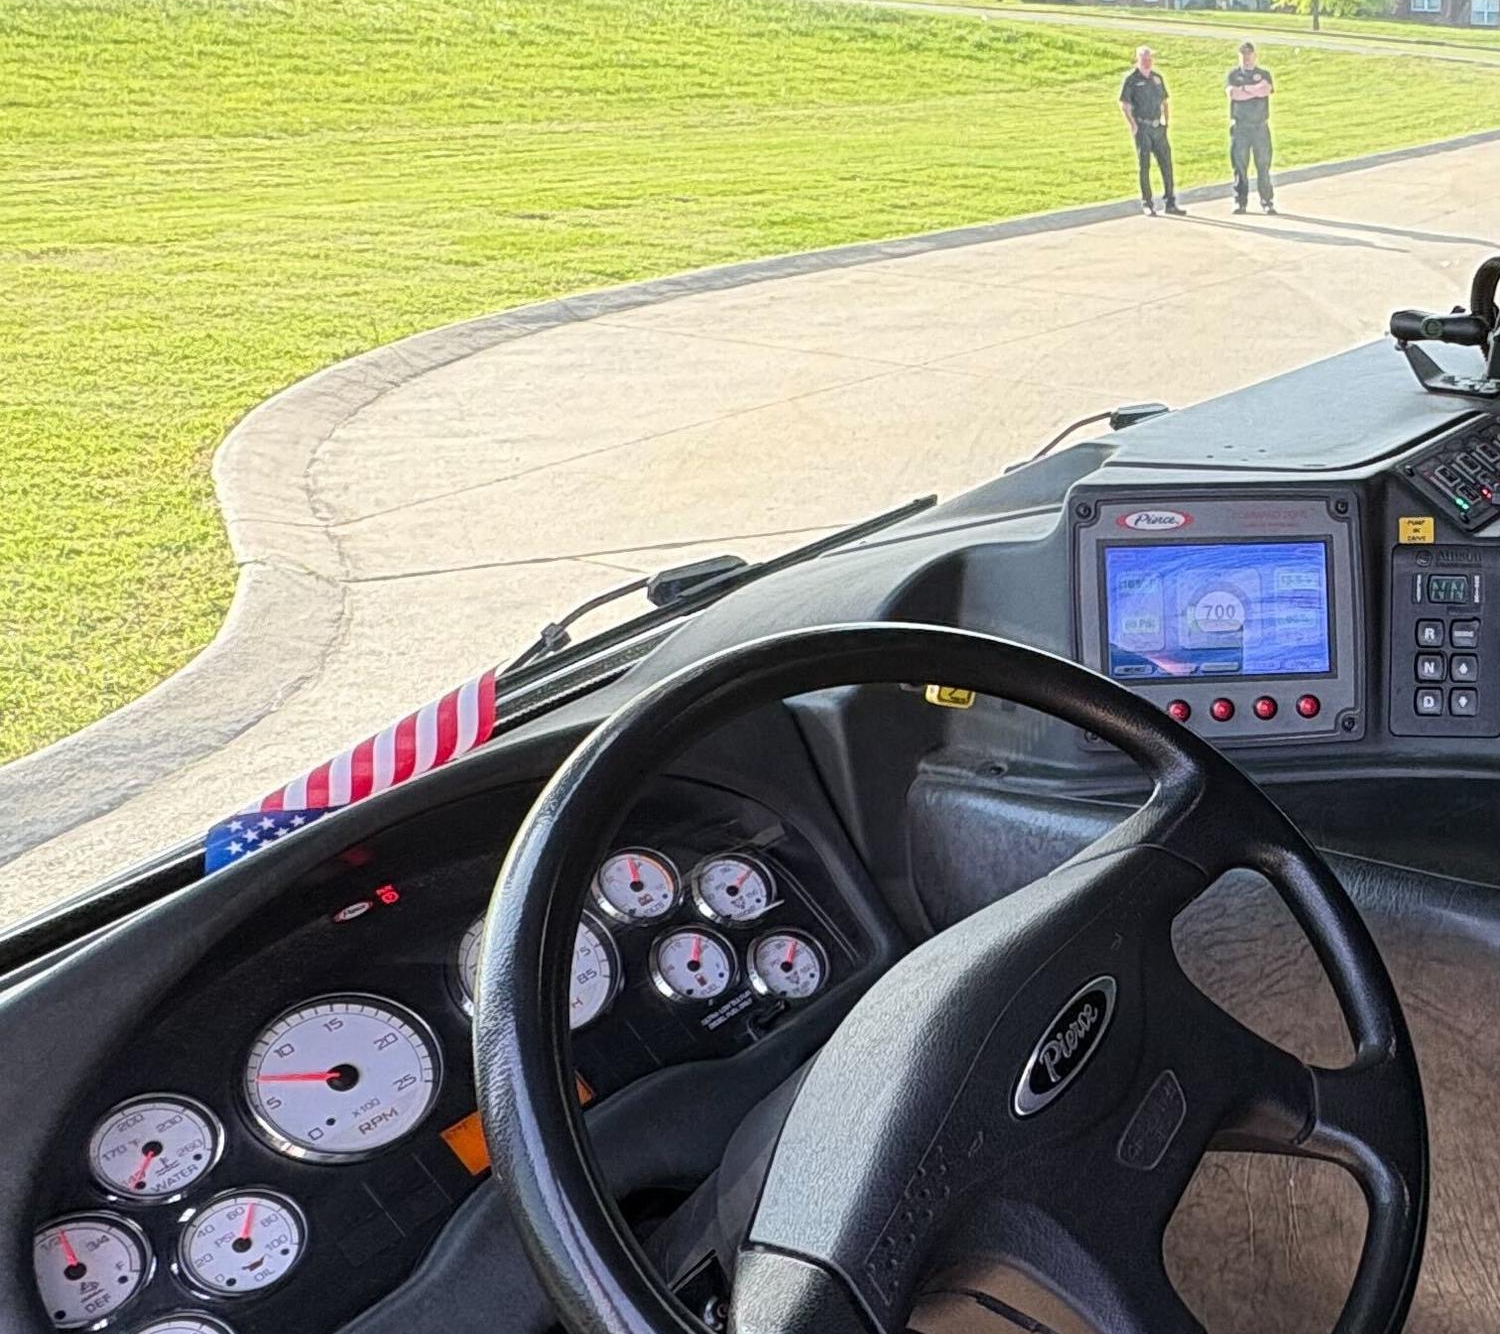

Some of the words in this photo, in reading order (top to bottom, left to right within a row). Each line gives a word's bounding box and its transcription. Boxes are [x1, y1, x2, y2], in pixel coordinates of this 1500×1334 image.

[1133, 513, 1178, 527] Pierce
[1203, 604, 1236, 620] 700
[1424, 627, 1435, 640] R
[1423, 661, 1435, 674] N
[1423, 696, 1435, 708] D
[577, 968, 598, 986] 85
[323, 1018, 344, 1033] 15
[373, 1032, 398, 1051] 20
[1039, 1004, 1098, 1083] Pierce
[273, 1043, 295, 1058] 10
[392, 1074, 417, 1092] 25
[266, 1096, 282, 1110] 5
[117, 1113, 144, 1133] 200
[156, 1114, 185, 1133] 230
[358, 1107, 399, 1135] RPM
[307, 1127, 324, 1141] 0
[101, 1144, 127, 1162] 170
[176, 1139, 202, 1157] 260
[150, 1163, 198, 1193] WATER
[226, 1205, 245, 1221] 60
[259, 1212, 279, 1228] 80
[195, 1224, 216, 1240] 40
[214, 1231, 236, 1248] PSI
[86, 1234, 110, 1252] 3/4
[264, 1234, 289, 1252] 100
[195, 1253, 214, 1269] 20
[253, 1266, 275, 1282] OIL
[84, 1293, 111, 1313] DEF
